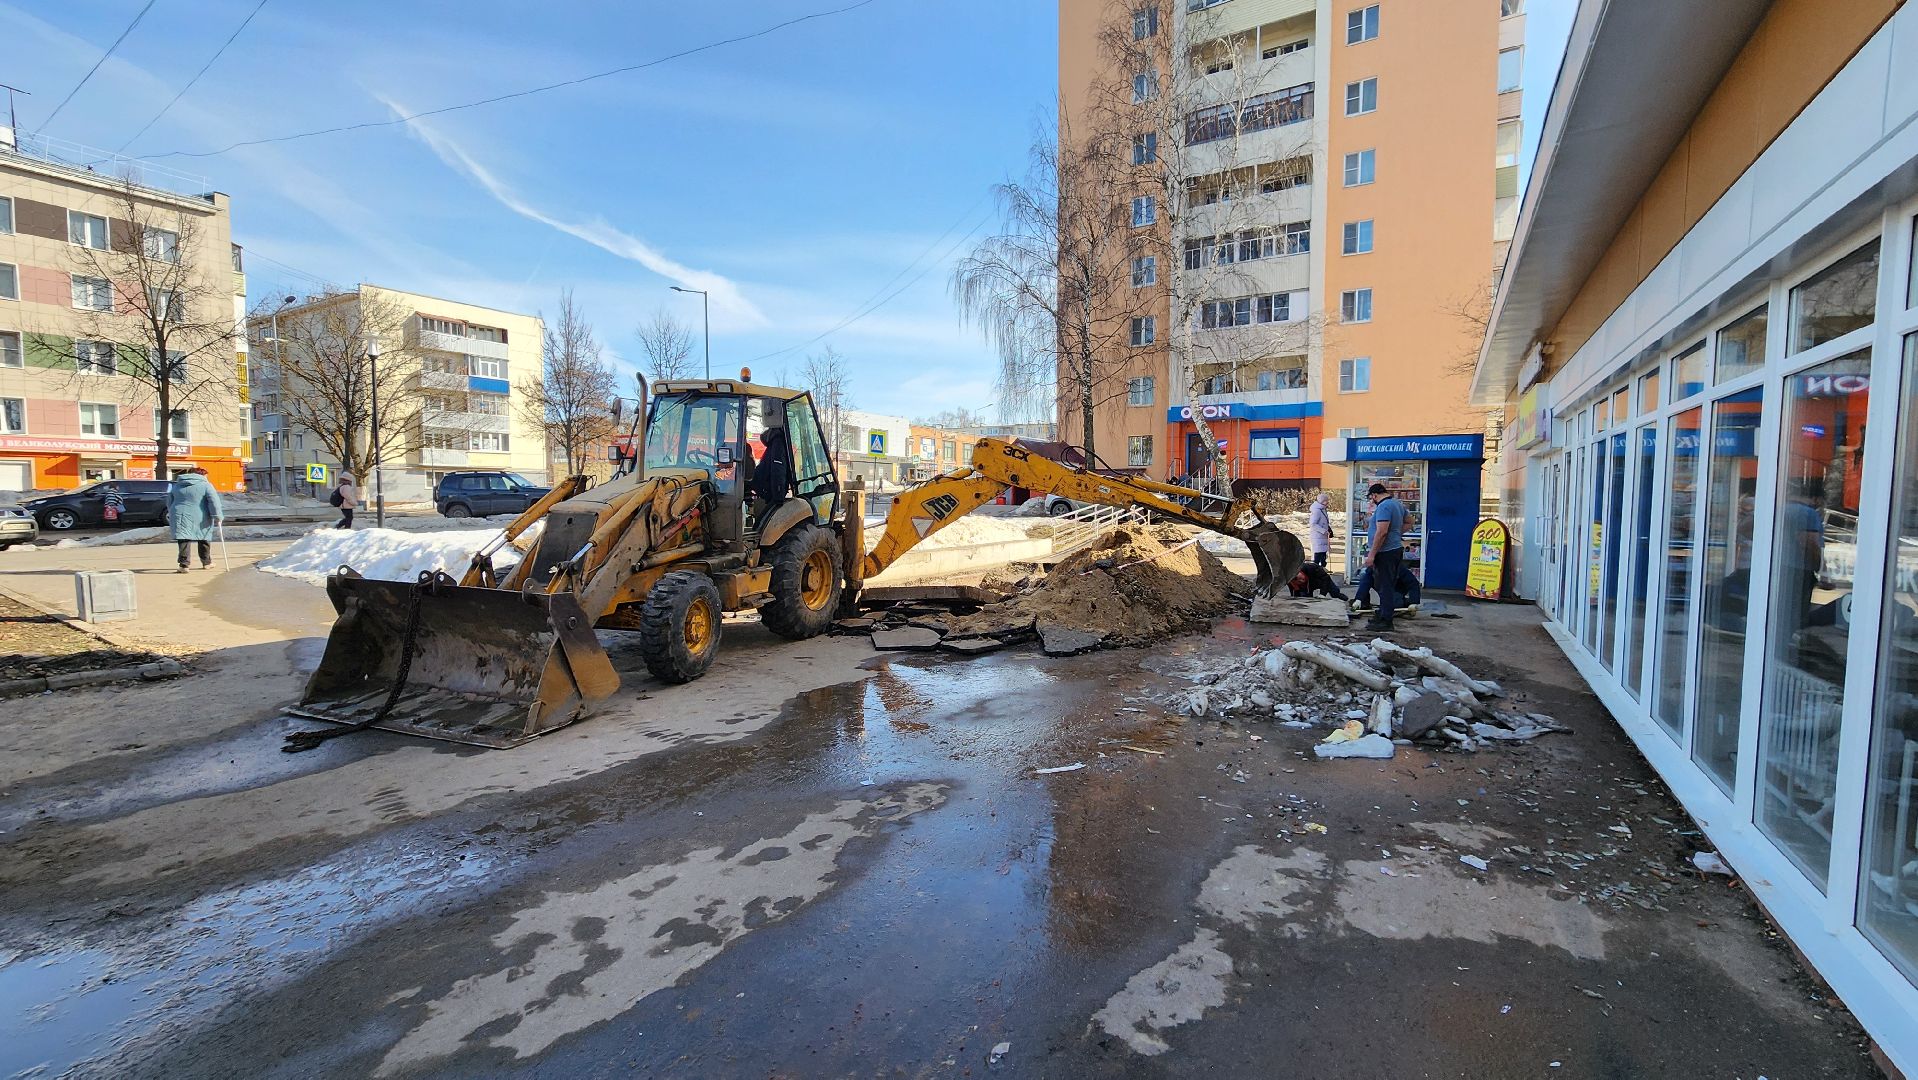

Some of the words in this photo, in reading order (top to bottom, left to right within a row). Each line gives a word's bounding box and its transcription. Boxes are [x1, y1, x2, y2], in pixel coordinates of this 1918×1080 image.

[1180, 405, 1231, 419] OON
[104, 443, 188, 453] МЯСОКОМНАТ
[1357, 443, 1404, 453] МОСКОВСКИЙ
[1405, 441, 1420, 453] МК
[1421, 442, 1473, 452] КОМСОМОЛЕЦ
[925, 494, 957, 521] JCB
